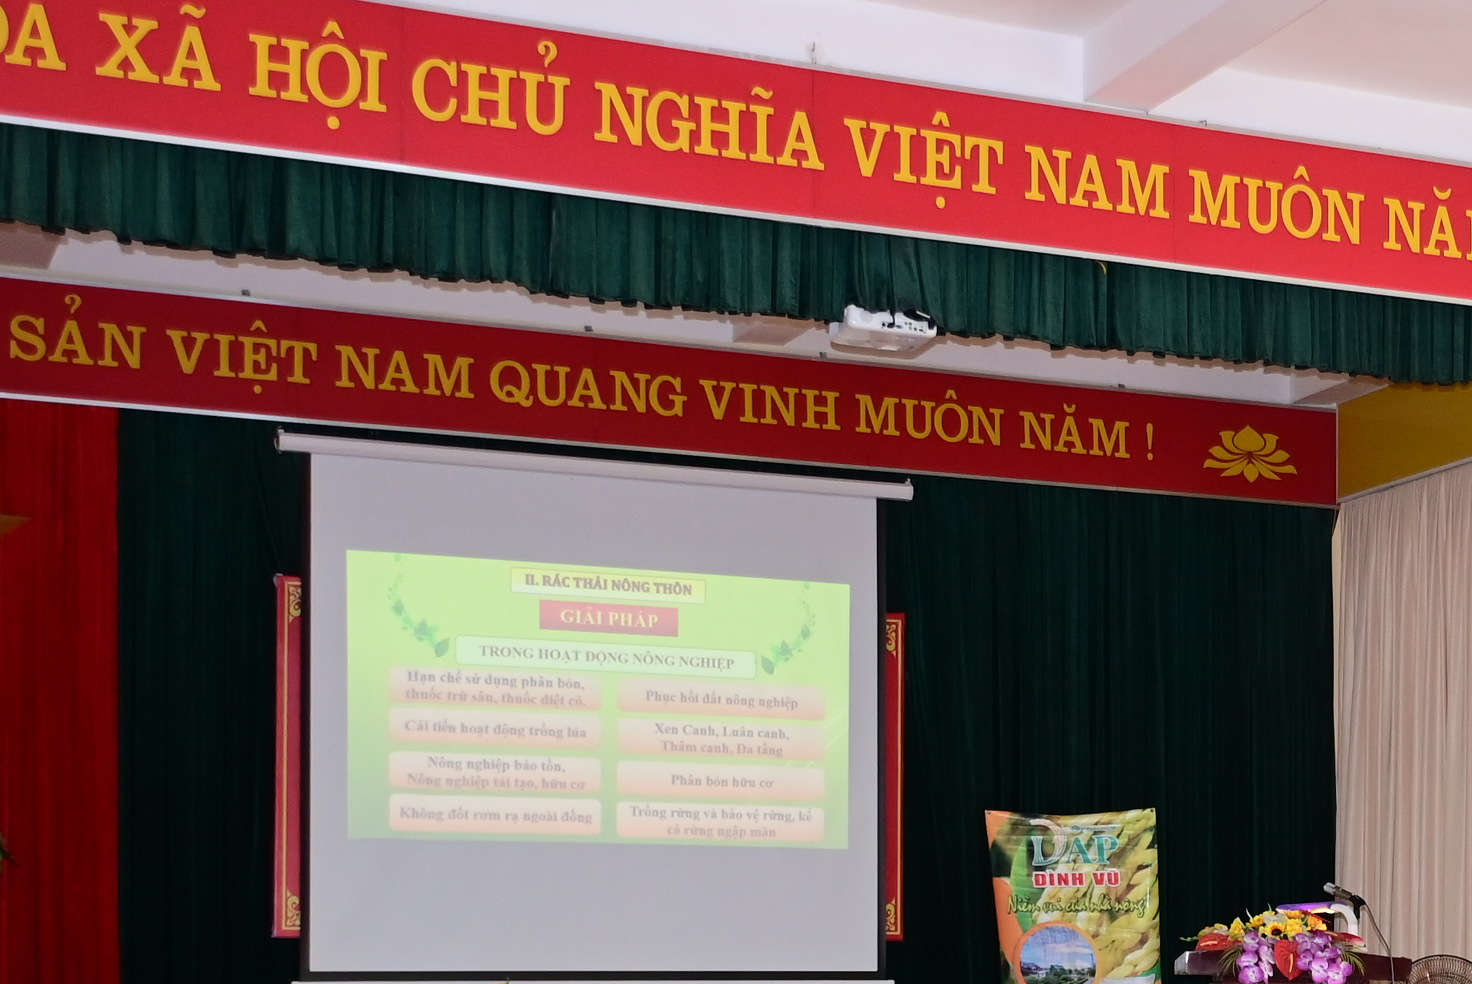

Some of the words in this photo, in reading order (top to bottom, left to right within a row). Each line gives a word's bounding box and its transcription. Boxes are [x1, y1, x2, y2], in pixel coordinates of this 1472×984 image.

[96, 4, 221, 91] XÃ
[250, 21, 387, 129] HỘI
[412, 41, 570, 135] CHỦ
[595, 82, 824, 170] NGHĨA
[844, 112, 1003, 208] VIỆT
[1025, 145, 1170, 218] NAM
[1189, 166, 1365, 244] MUÔN
[9, 293, 145, 369] SẢN
[168, 321, 316, 392] VIỆT
[337, 346, 473, 398] NAM
[491, 361, 687, 416] QUANG
[698, 379, 841, 431] VINH
[856, 390, 1003, 445] MUÔN
[1021, 402, 1129, 457] NĂM
[542, 573, 571, 588] RÁC
[573, 576, 608, 590] THẢI
[611, 579, 650, 593] NÔNG
[653, 581, 692, 596] THÔN
[560, 606, 602, 625] GIẢI
[608, 611, 659, 628] PHÁP
[479, 645, 534, 660] TRONG
[538, 649, 582, 666] HOẠT
[633, 650, 675, 667] NÔNG
[679, 656, 735, 672] NGHIỆP
[407, 670, 436, 685] Hạn
[440, 670, 462, 684] chế
[484, 674, 517, 689] dụng
[521, 676, 553, 690] phân
[646, 690, 677, 706] Phục
[680, 689, 699, 704] hồi
[702, 689, 721, 704] đất
[726, 694, 755, 709] nông
[758, 696, 798, 711] nghiệp
[655, 723, 678, 735] Xen
[723, 726, 754, 739] Luân
[671, 774, 701, 786] Phân
[1030, 818, 1120, 867] DAP
[1034, 870, 1085, 887] ĐÌNH
